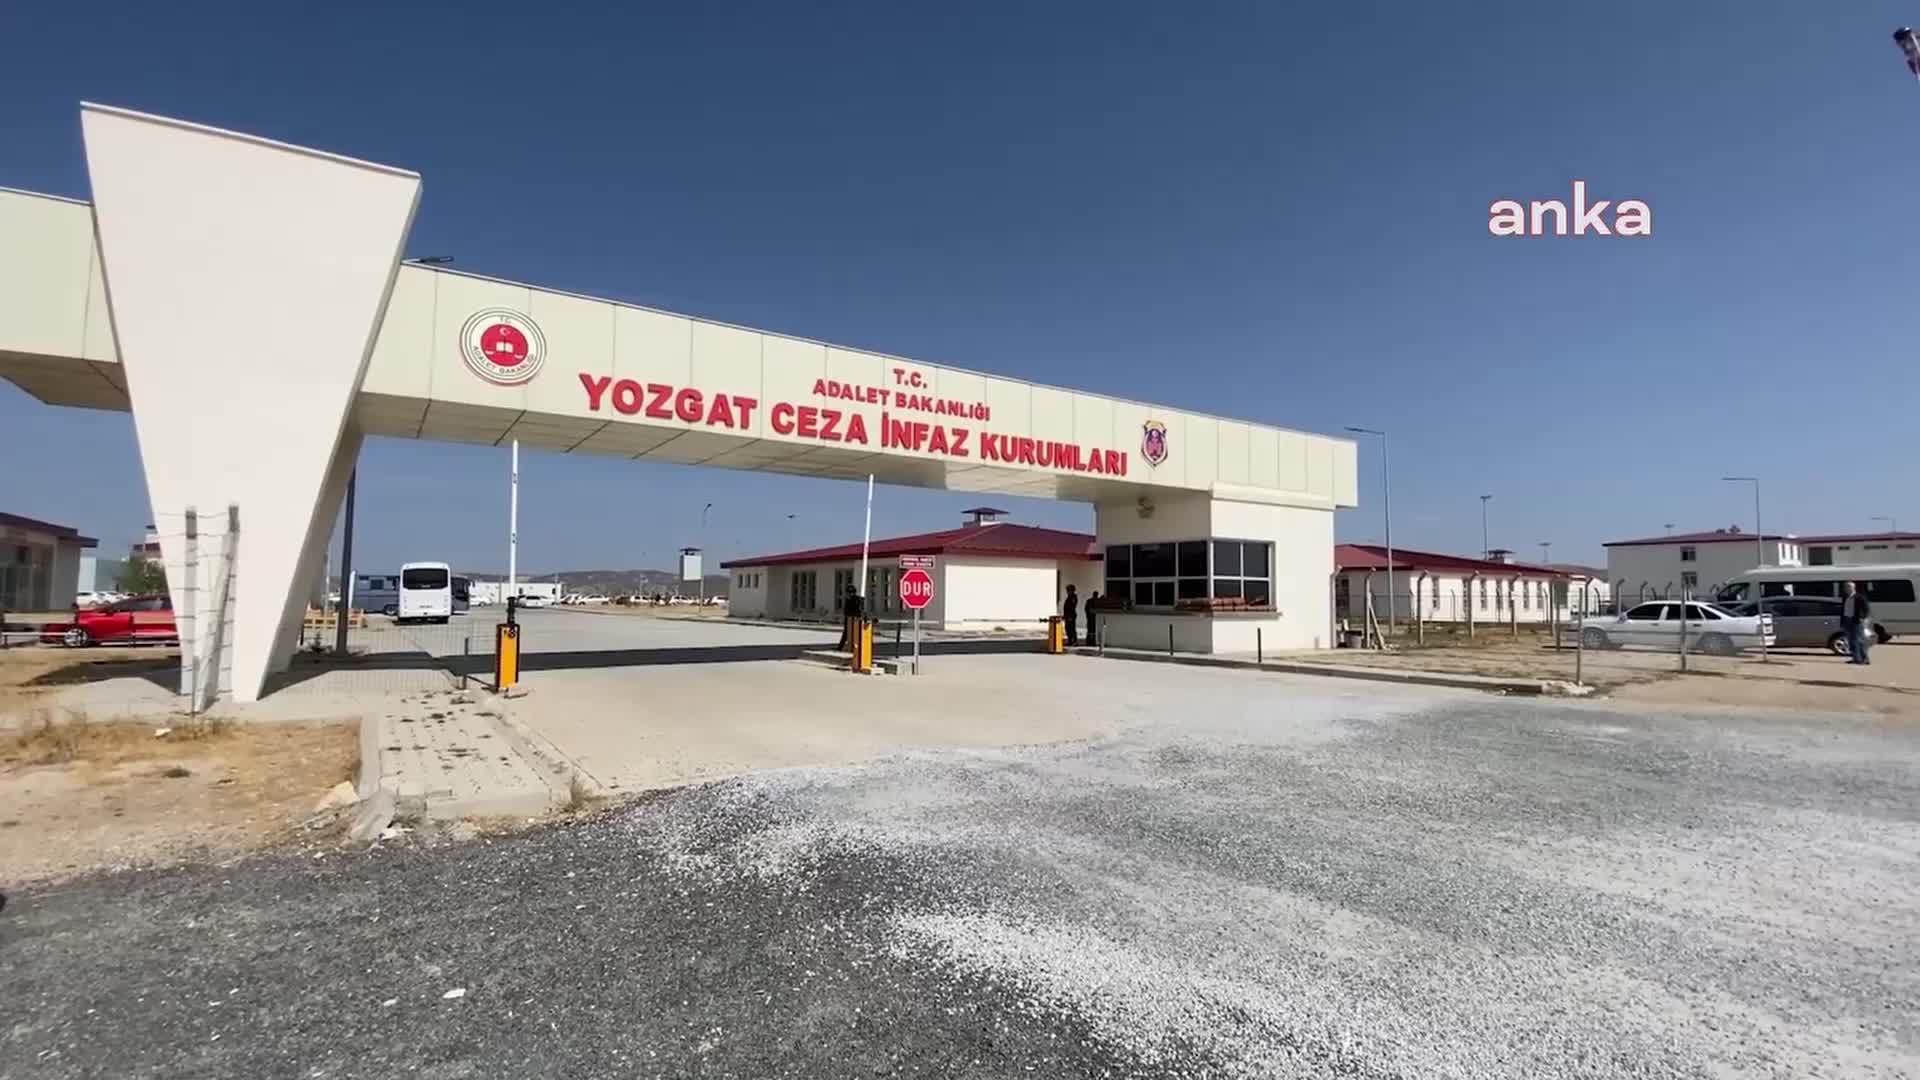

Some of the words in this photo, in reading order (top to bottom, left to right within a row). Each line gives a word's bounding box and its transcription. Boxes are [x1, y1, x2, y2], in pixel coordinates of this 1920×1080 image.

[893, 368, 928, 389] T.C.
[812, 378, 890, 406] ADALET
[895, 391, 991, 421] BAKANLIĞI
[579, 373, 757, 430] YOZGAT
[771, 402, 868, 444] CEZA
[881, 411, 970, 457] İNFAZ
[980, 431, 1128, 477] KURUMLARI
[903, 581, 931, 597] DUR
